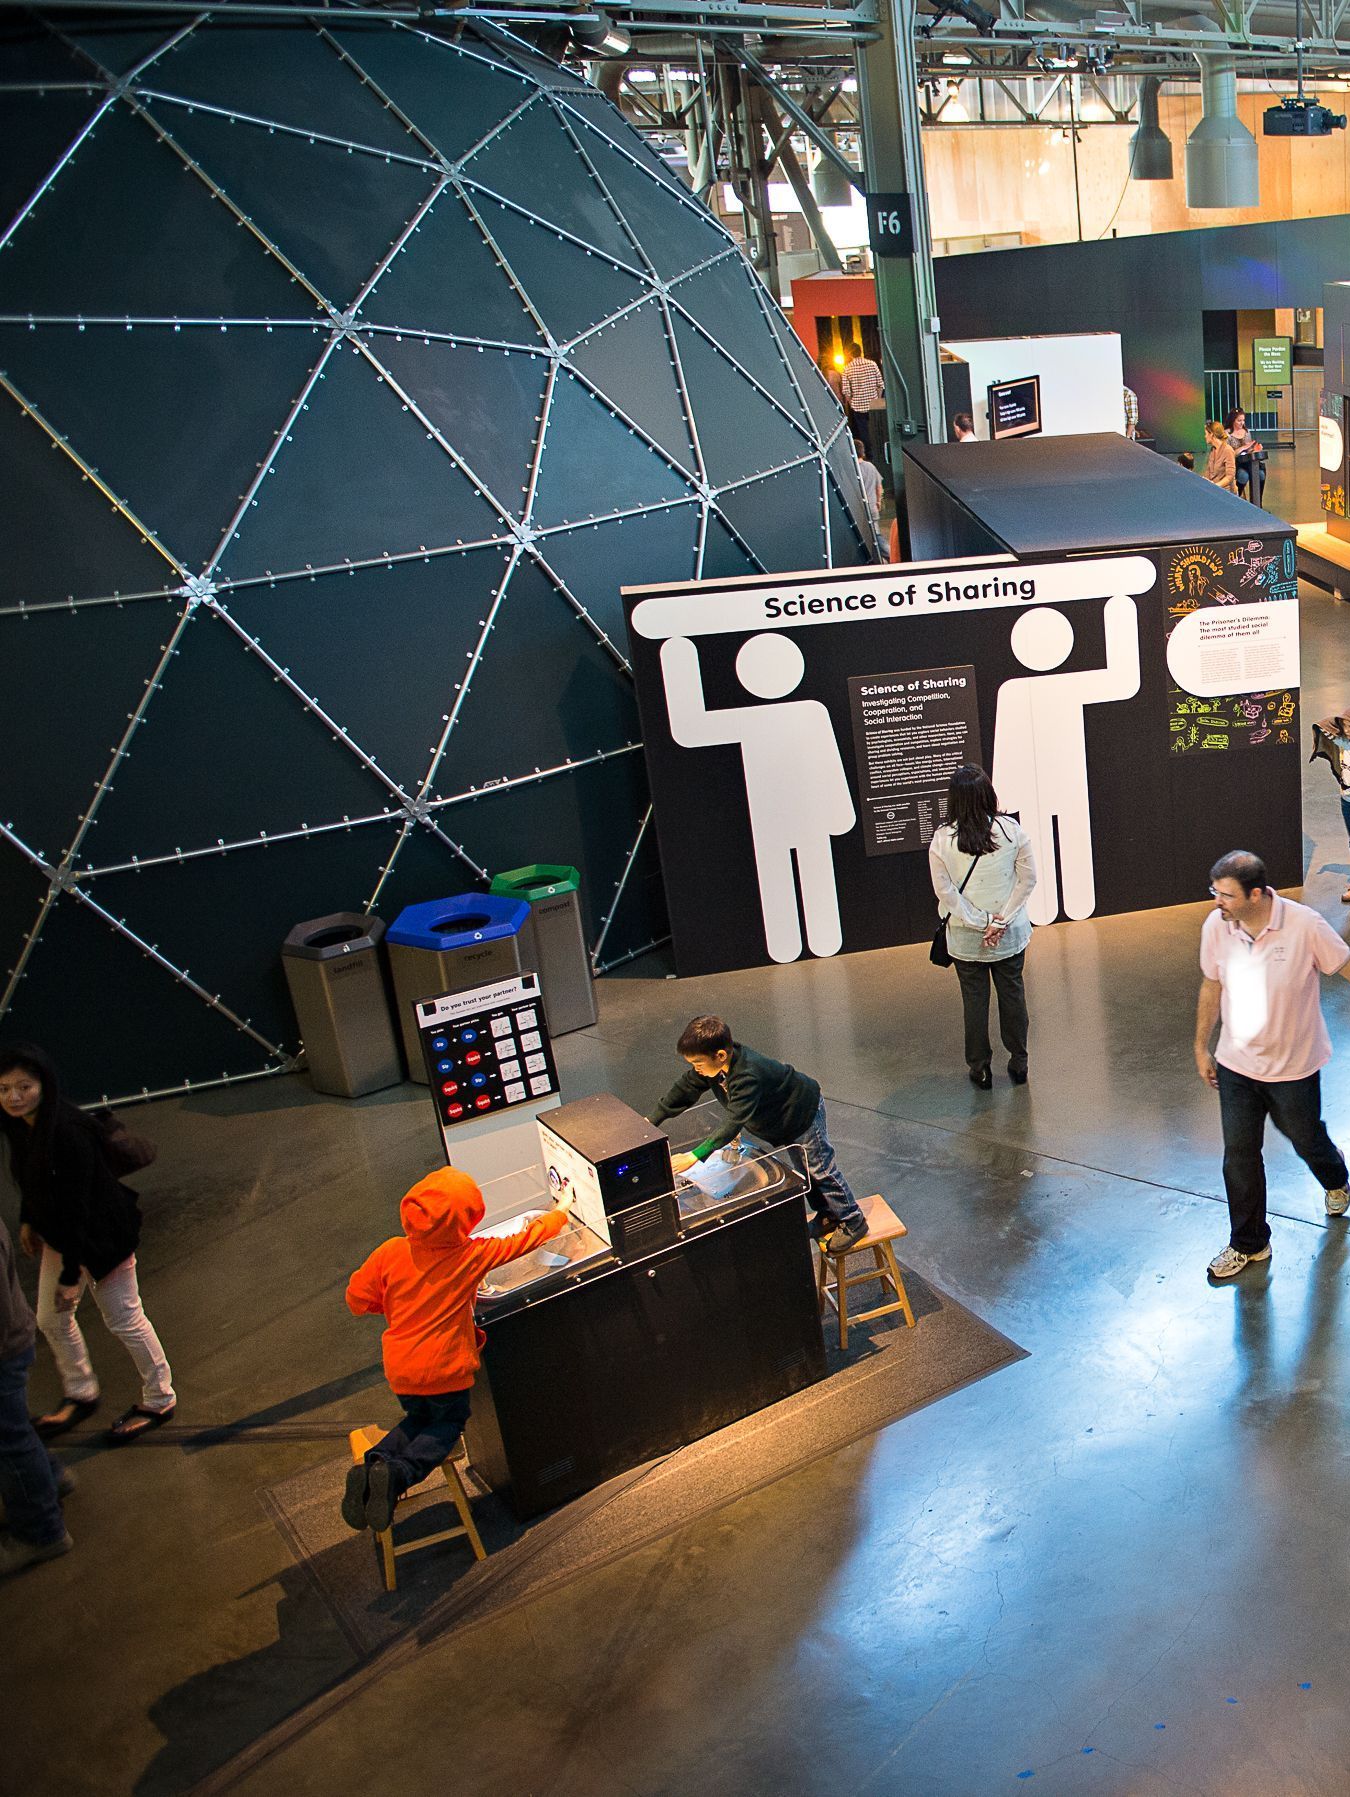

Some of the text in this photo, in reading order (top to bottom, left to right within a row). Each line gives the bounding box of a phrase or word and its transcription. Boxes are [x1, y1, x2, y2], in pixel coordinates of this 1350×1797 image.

[876, 211, 900, 235] F6
[764, 577, 1036, 618] Science of Sharing
[860, 677, 966, 696] Science of Sharing
[862, 692, 950, 708] Investigating Competition,
[863, 703, 923, 717] Cooperation, and
[864, 713, 923, 726] Social Interaction
[538, 901, 570, 916] compost
[464, 950, 494, 962] recycle
[333, 960, 364, 974] landfill
[493, 987, 517, 998] partner?
